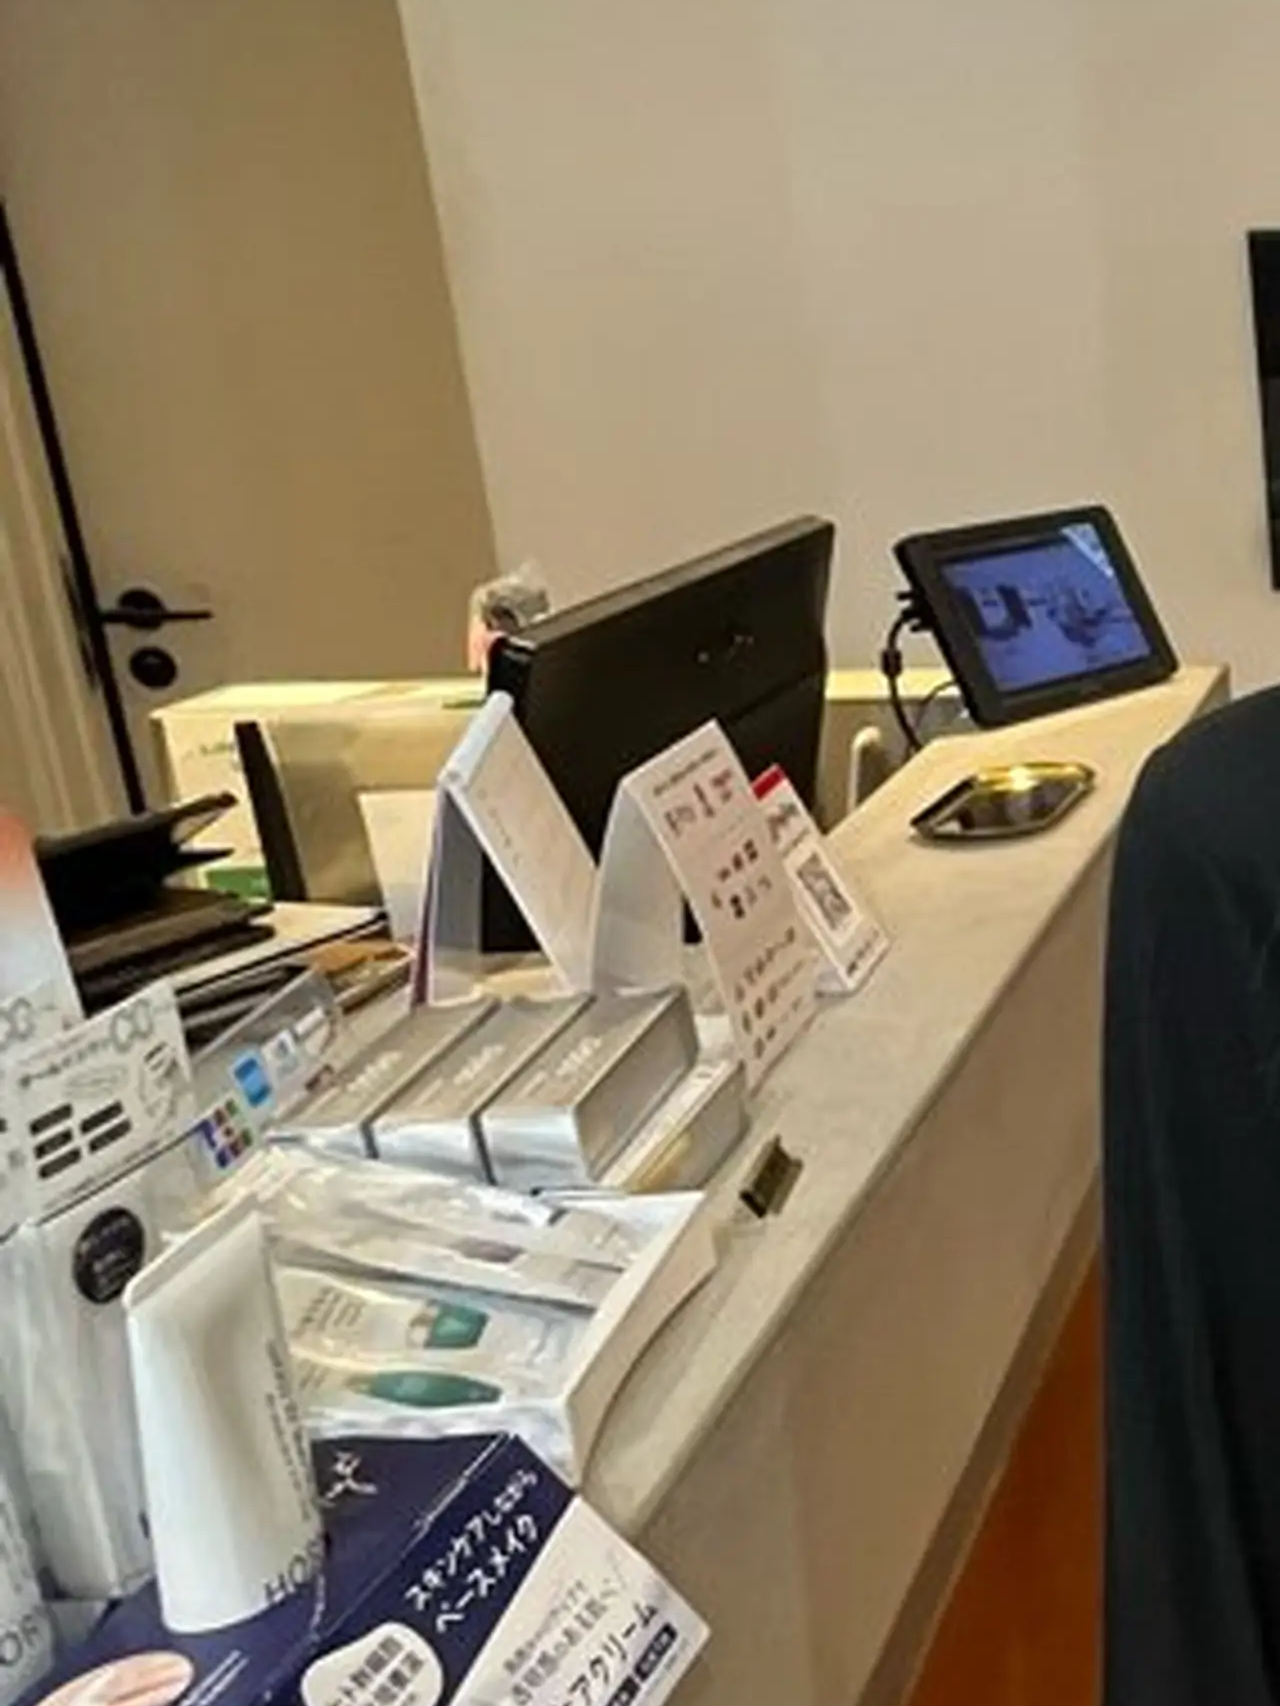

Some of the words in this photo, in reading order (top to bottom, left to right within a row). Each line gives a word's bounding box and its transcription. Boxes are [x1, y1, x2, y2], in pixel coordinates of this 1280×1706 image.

[404, 1468, 538, 1611] スキンケアしながら
